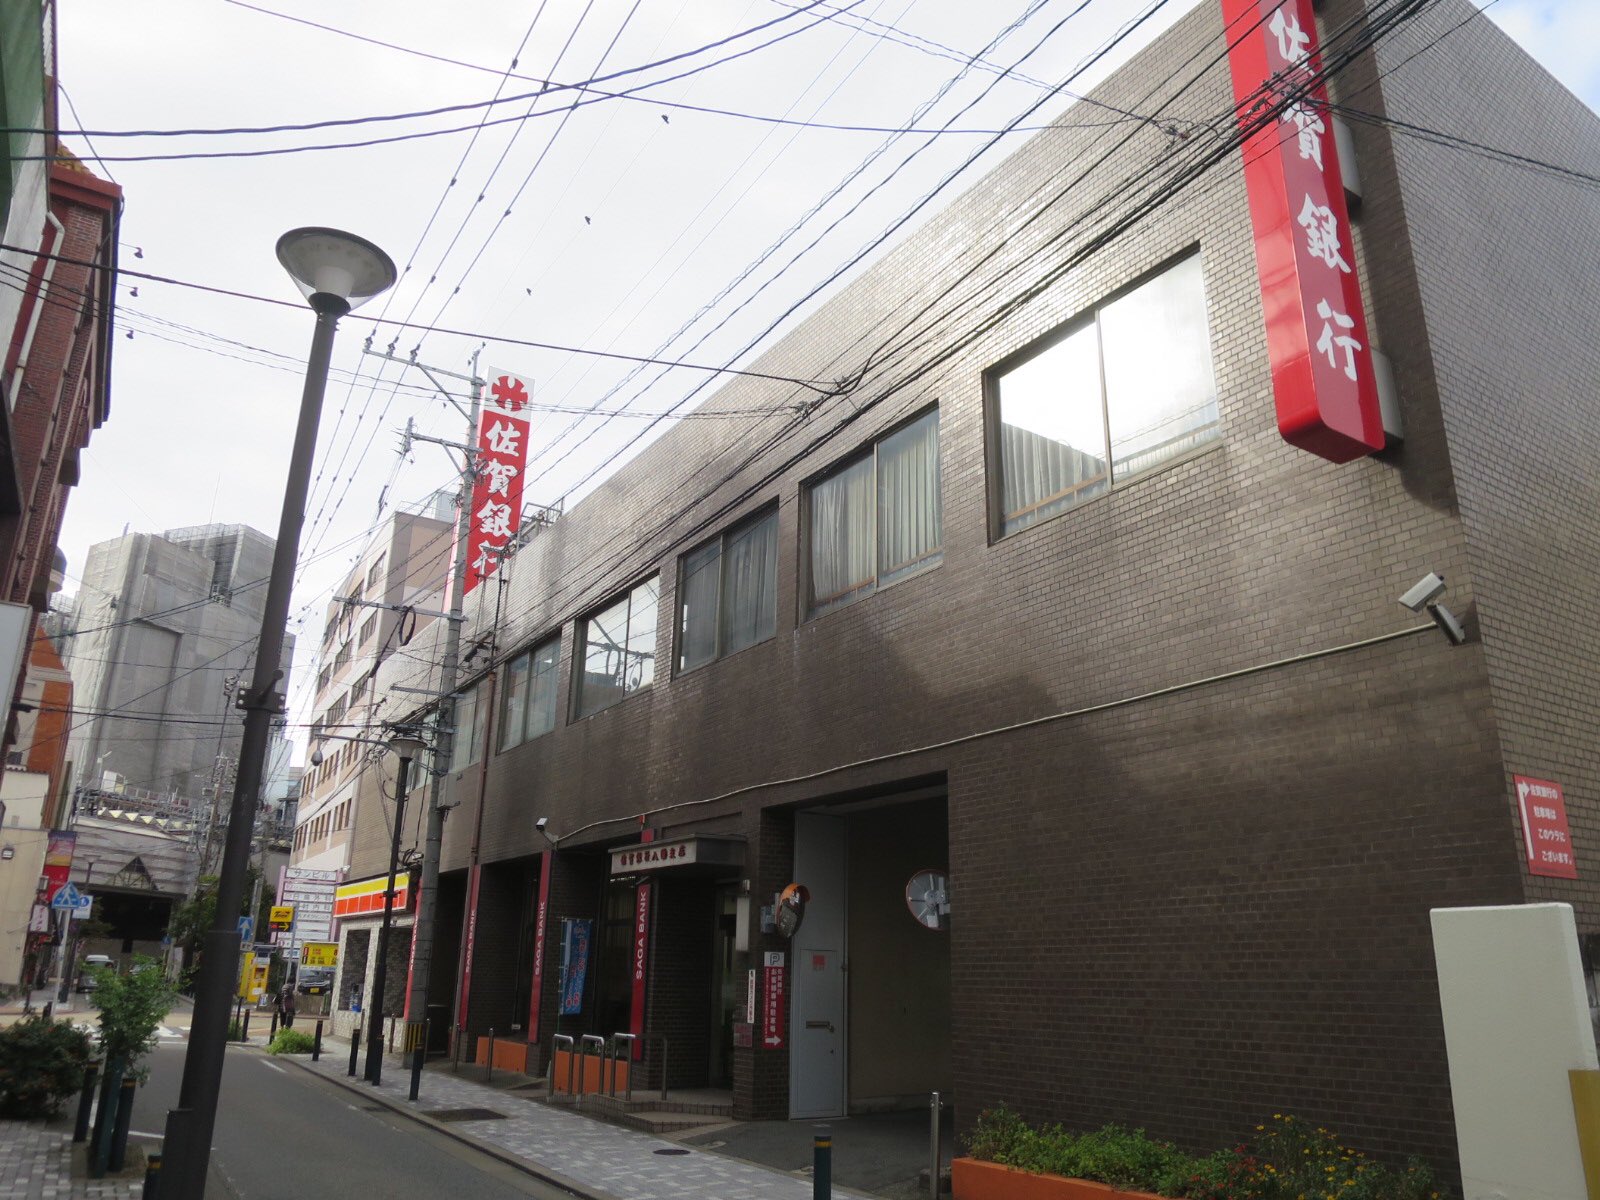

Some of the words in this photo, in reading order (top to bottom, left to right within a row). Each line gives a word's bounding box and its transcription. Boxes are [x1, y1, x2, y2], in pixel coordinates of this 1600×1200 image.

[1268, 8, 1362, 382] 佐賀銀行
[471, 419, 521, 577] 佐賀銀行
[1537, 828, 1567, 843] このウラに
[537, 902, 545, 937] BANK
[638, 891, 647, 933] BANK
[636, 938, 644, 980] SAGA
